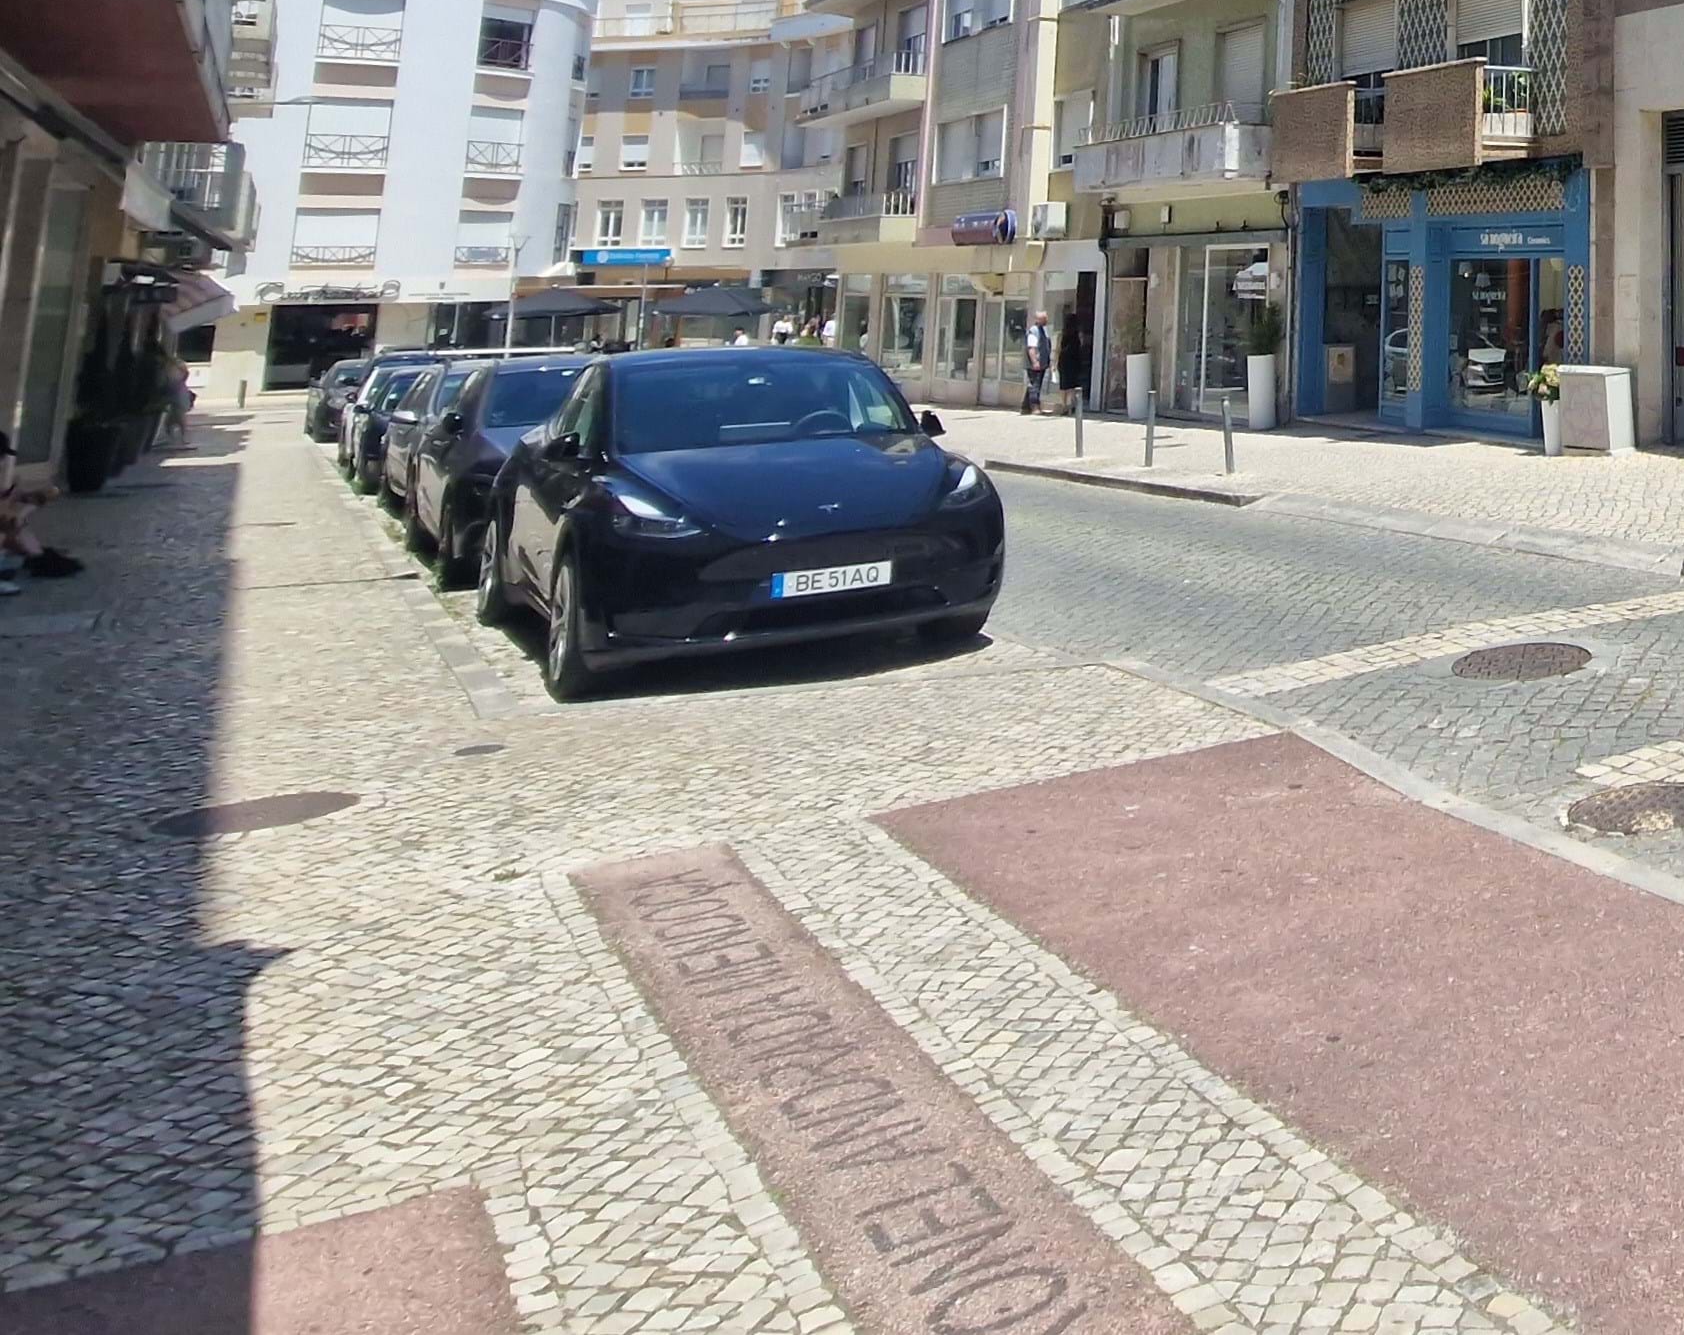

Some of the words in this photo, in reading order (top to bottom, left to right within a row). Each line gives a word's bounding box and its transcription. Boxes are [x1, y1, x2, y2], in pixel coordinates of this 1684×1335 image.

[796, 572, 825, 592] BE
[828, 570, 847, 588] 51
[851, 566, 879, 585] AQ
